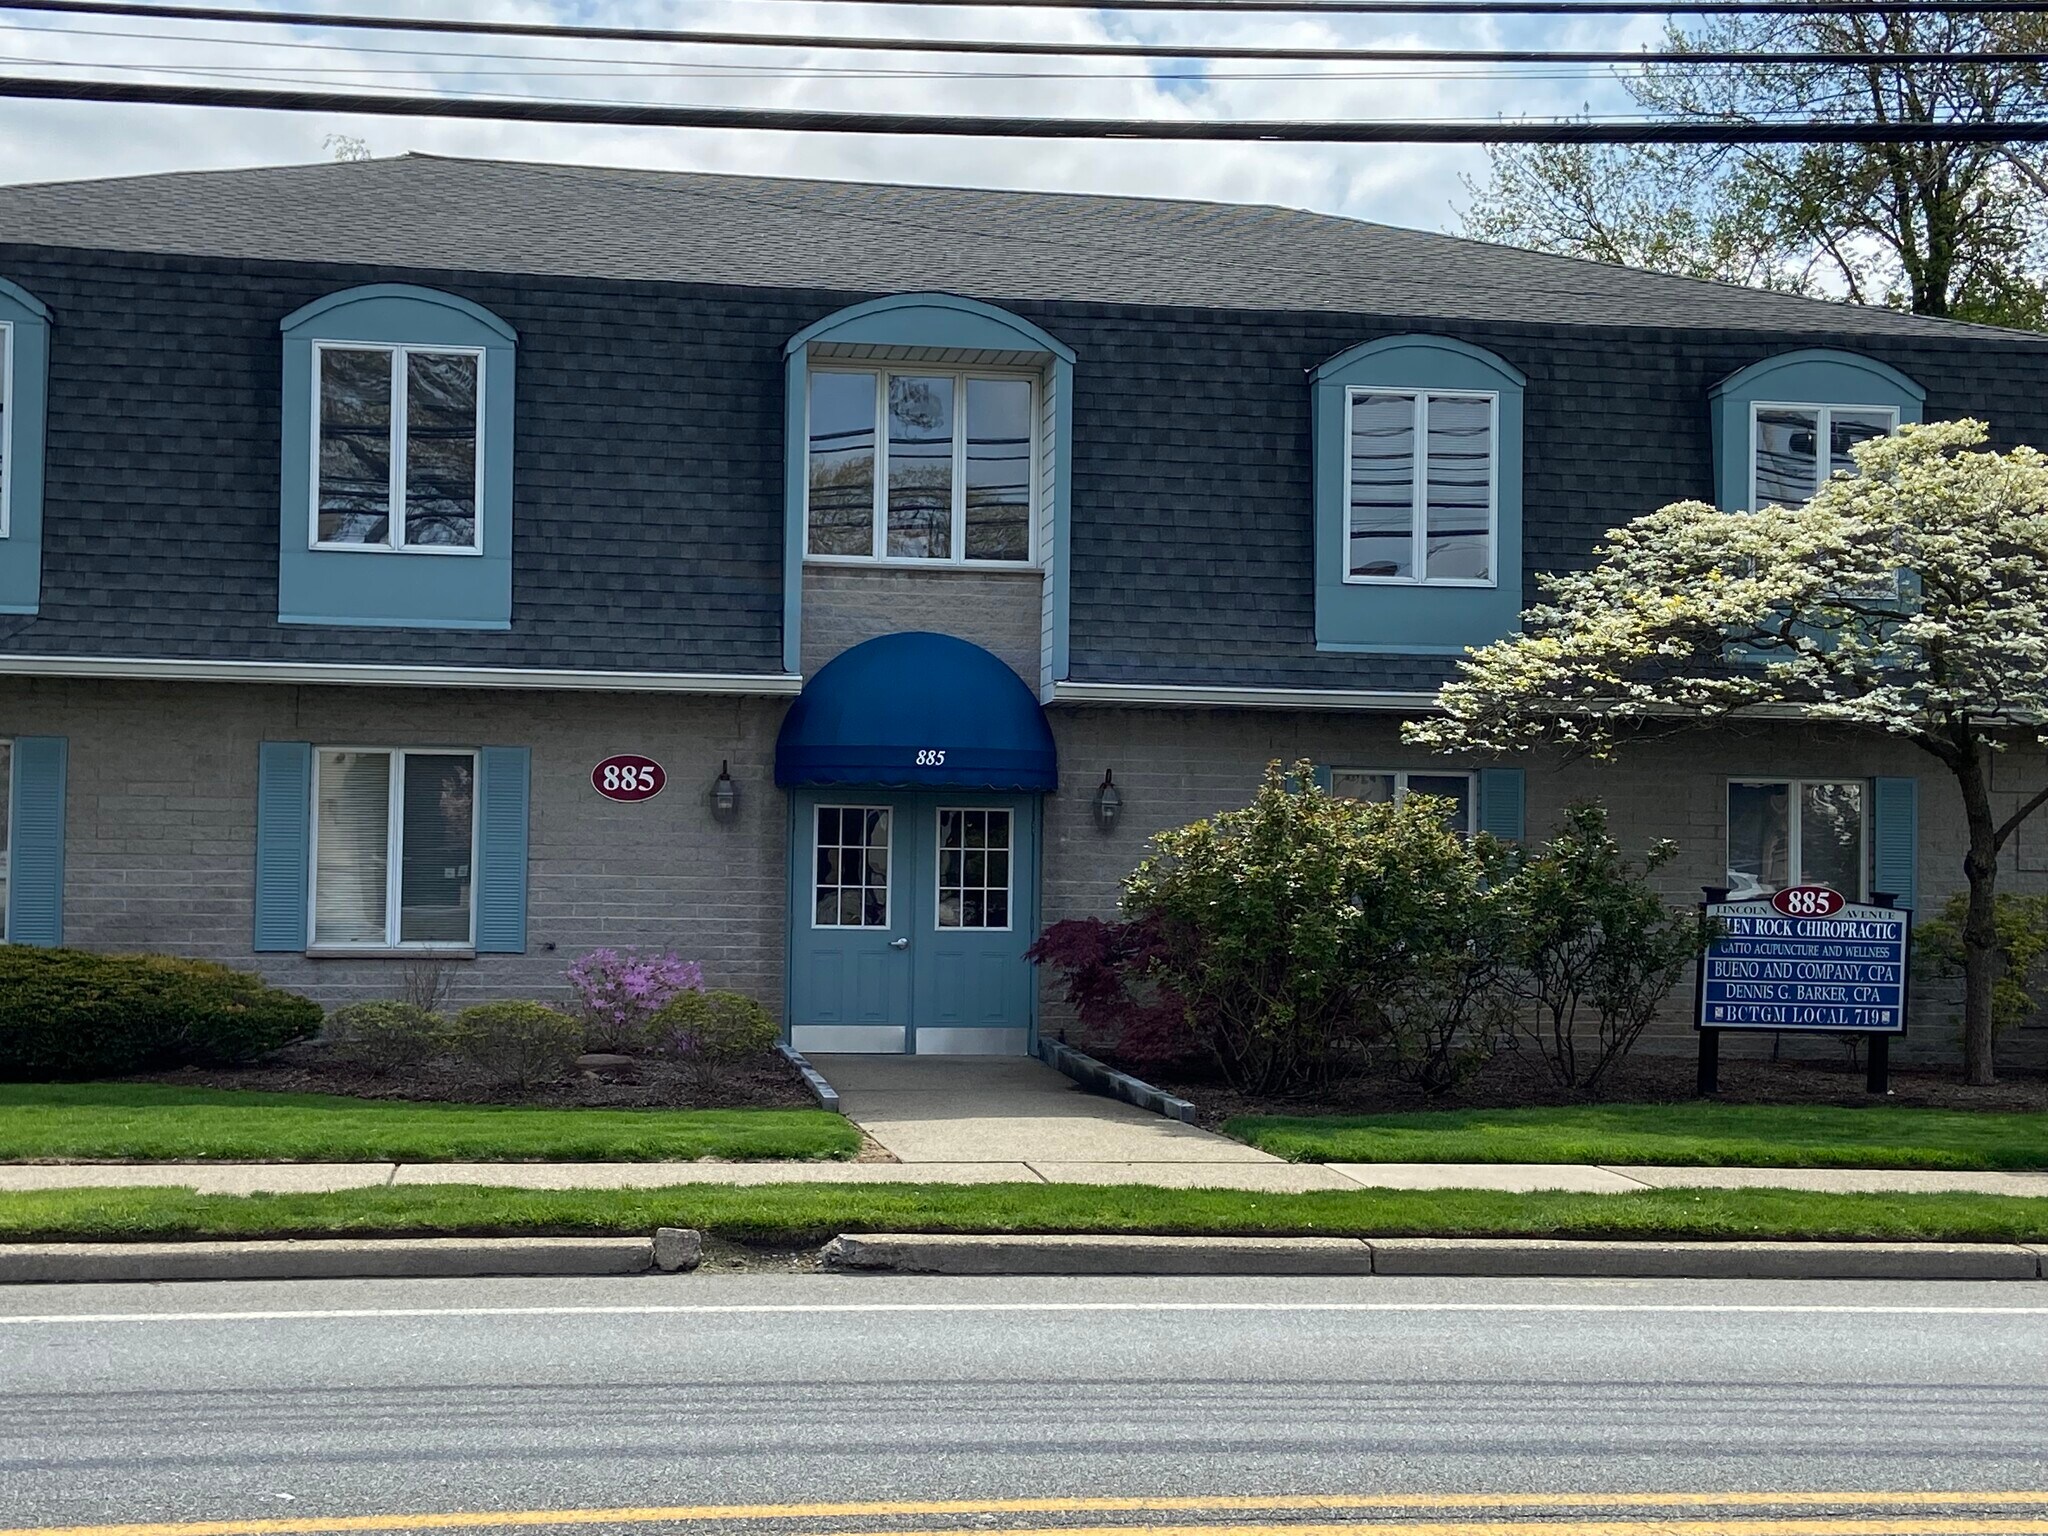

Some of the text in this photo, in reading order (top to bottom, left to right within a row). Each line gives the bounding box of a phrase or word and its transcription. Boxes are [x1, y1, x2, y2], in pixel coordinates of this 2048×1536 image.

[916, 750, 946, 766] 885
[603, 765, 655, 791] 885
[1716, 905, 1896, 920] LINCOLN AVENUE
[1788, 891, 1830, 914] 885
[1724, 918, 1896, 940] LEN ROCK CHIROPRACTIC
[1721, 943, 1890, 958] GATTO ACUPUNCTURE AND WELLNESS
[1715, 962, 1894, 982] BUENO AND COMPANY, CPA
[1726, 983, 1881, 1003] DENNIS G. BARKER, CPA
[1726, 1005, 1880, 1025] BCTGM LOCAL 719
